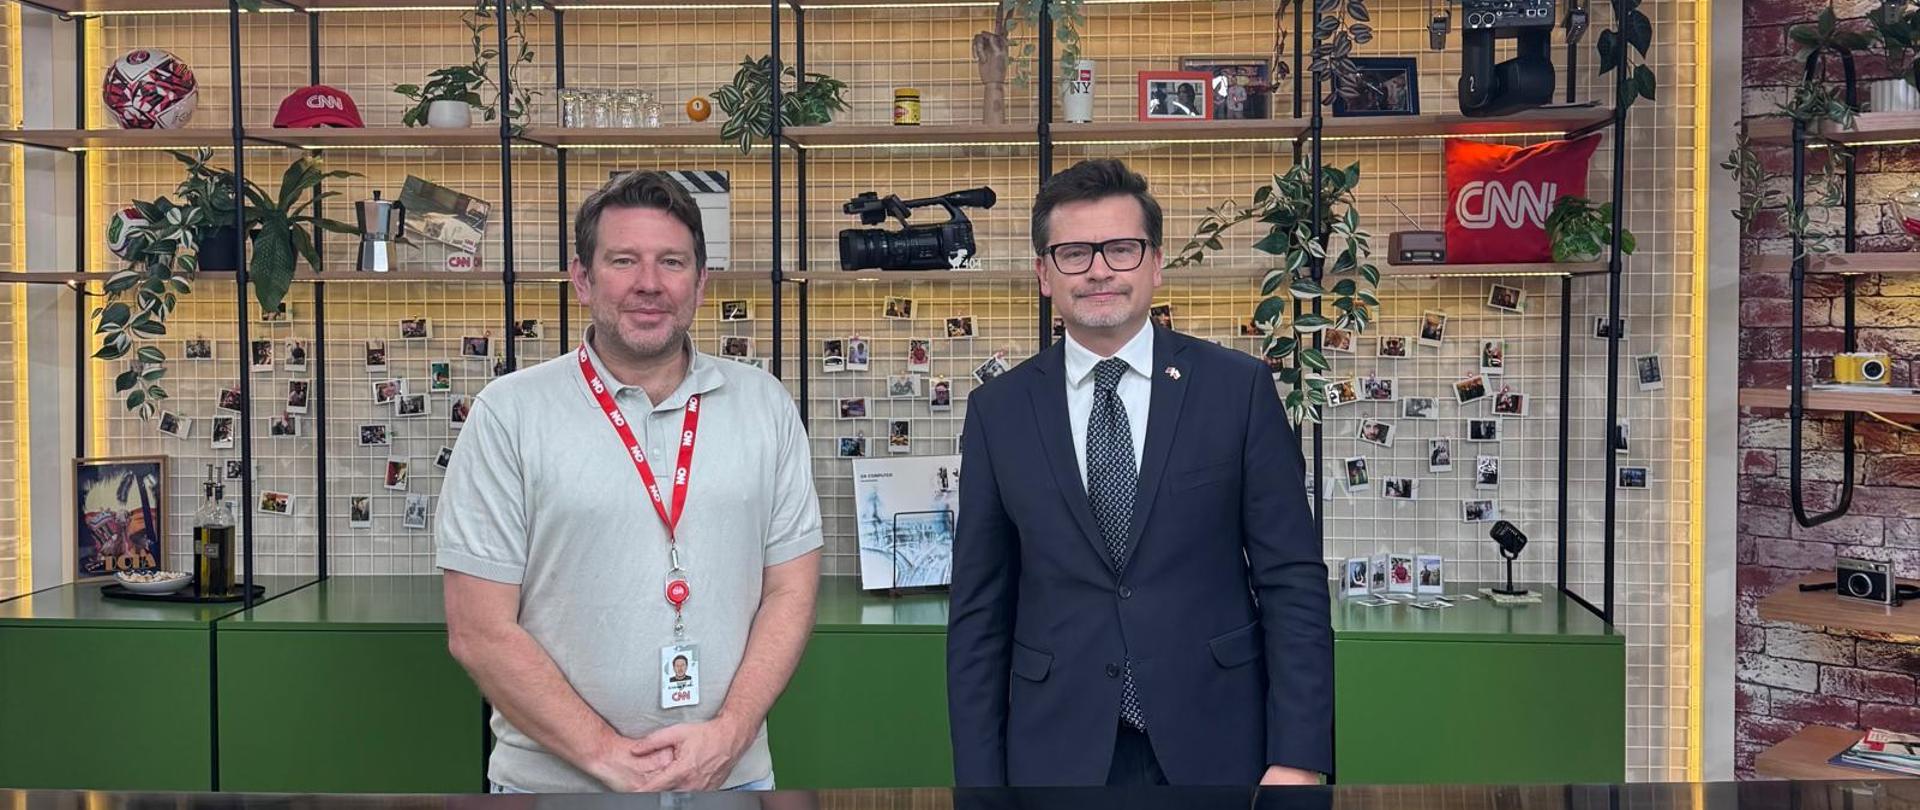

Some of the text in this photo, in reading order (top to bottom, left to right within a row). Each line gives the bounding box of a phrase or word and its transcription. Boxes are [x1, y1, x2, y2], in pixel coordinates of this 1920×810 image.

[1070, 81, 1091, 94] NY
[306, 94, 344, 111] CNN
[1455, 180, 1558, 230] CNN
[449, 256, 471, 268] CNN
[590, 376, 604, 394] CNN
[609, 409, 625, 427] CNN
[682, 430, 693, 447] CNN
[630, 445, 644, 463] CNN
[676, 467, 687, 485] CNN
[672, 691, 690, 702] CNN
